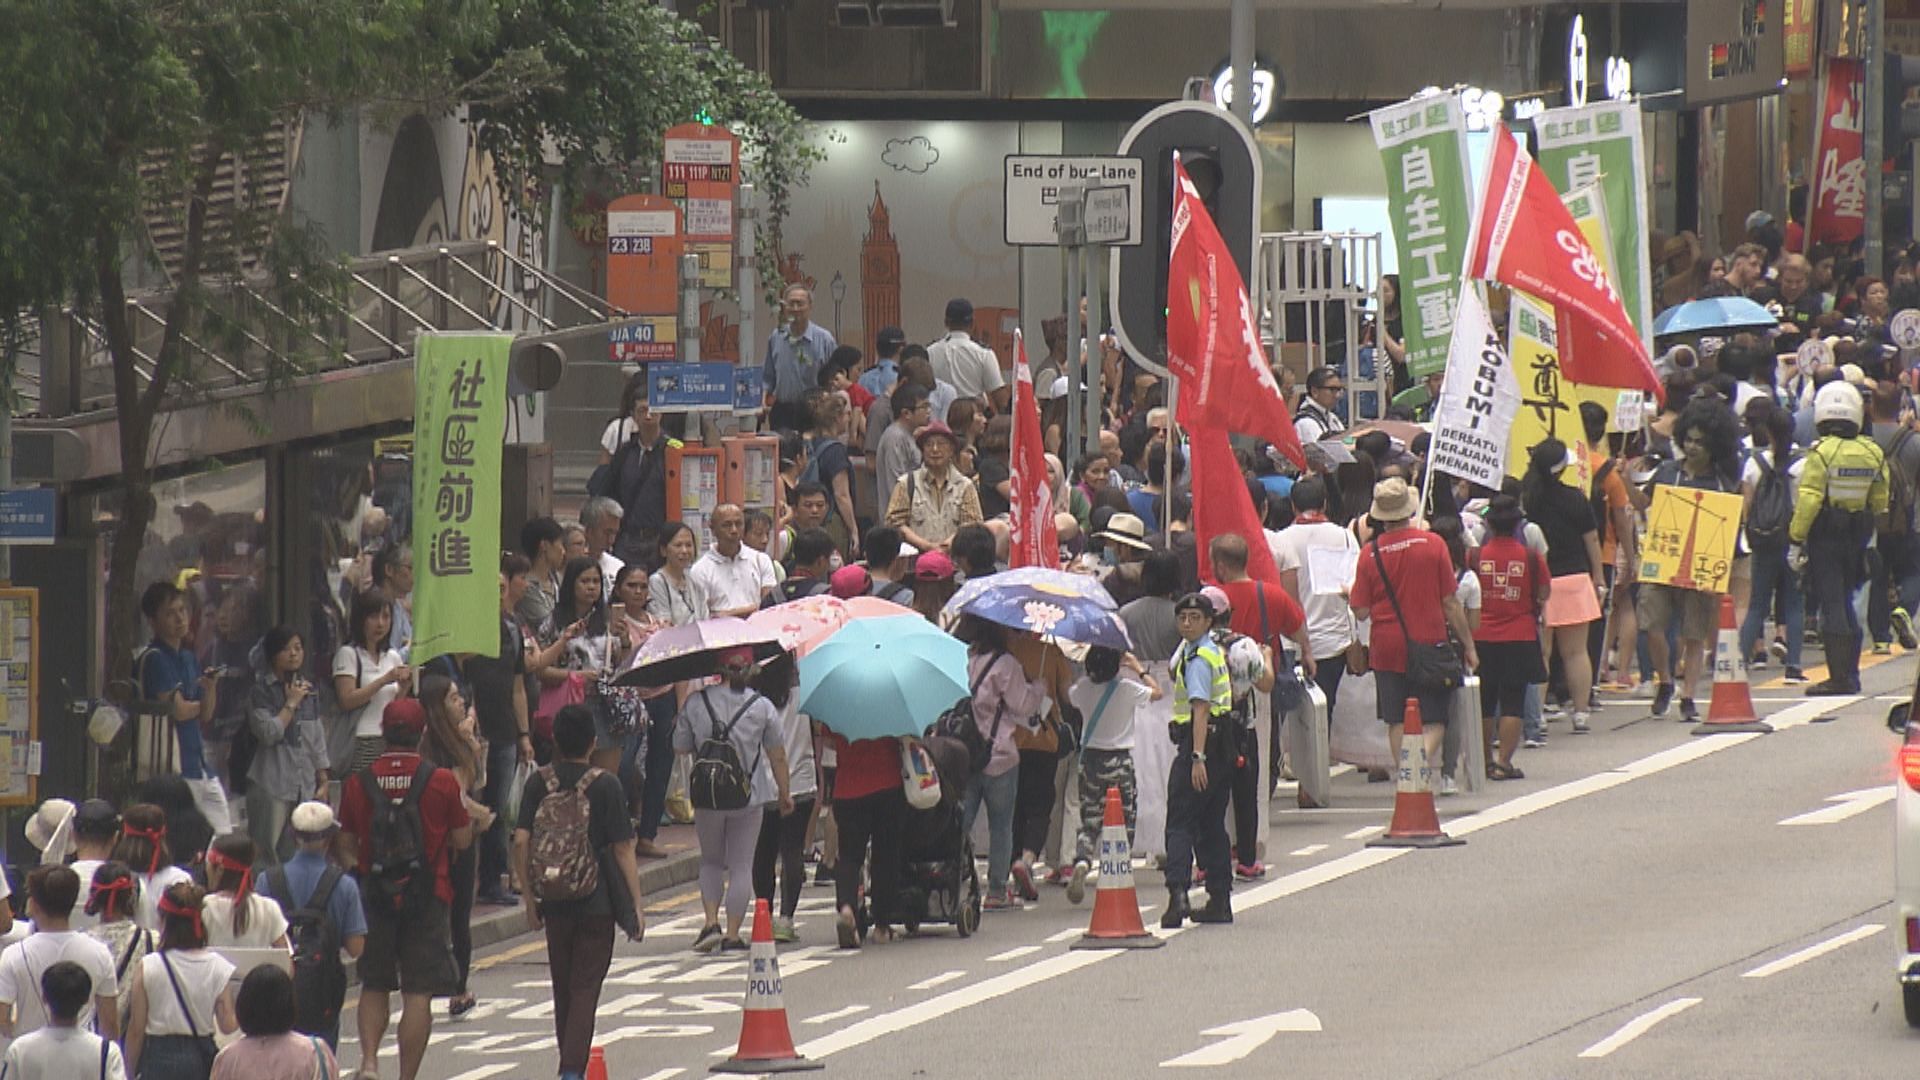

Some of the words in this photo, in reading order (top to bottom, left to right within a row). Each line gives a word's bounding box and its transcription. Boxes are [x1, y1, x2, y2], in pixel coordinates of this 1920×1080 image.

[668, 164, 685, 180] 111
[689, 165, 708, 181] 111P
[1013, 163, 1043, 178] End
[1048, 163, 1065, 178] of
[1102, 163, 1137, 179] lane
[611, 238, 628, 254] 23
[632, 238, 651, 253] 23B
[634, 326, 651, 342] 40
[1441, 428, 1498, 453] BERSATU
[1434, 453, 1490, 480] MENANG
